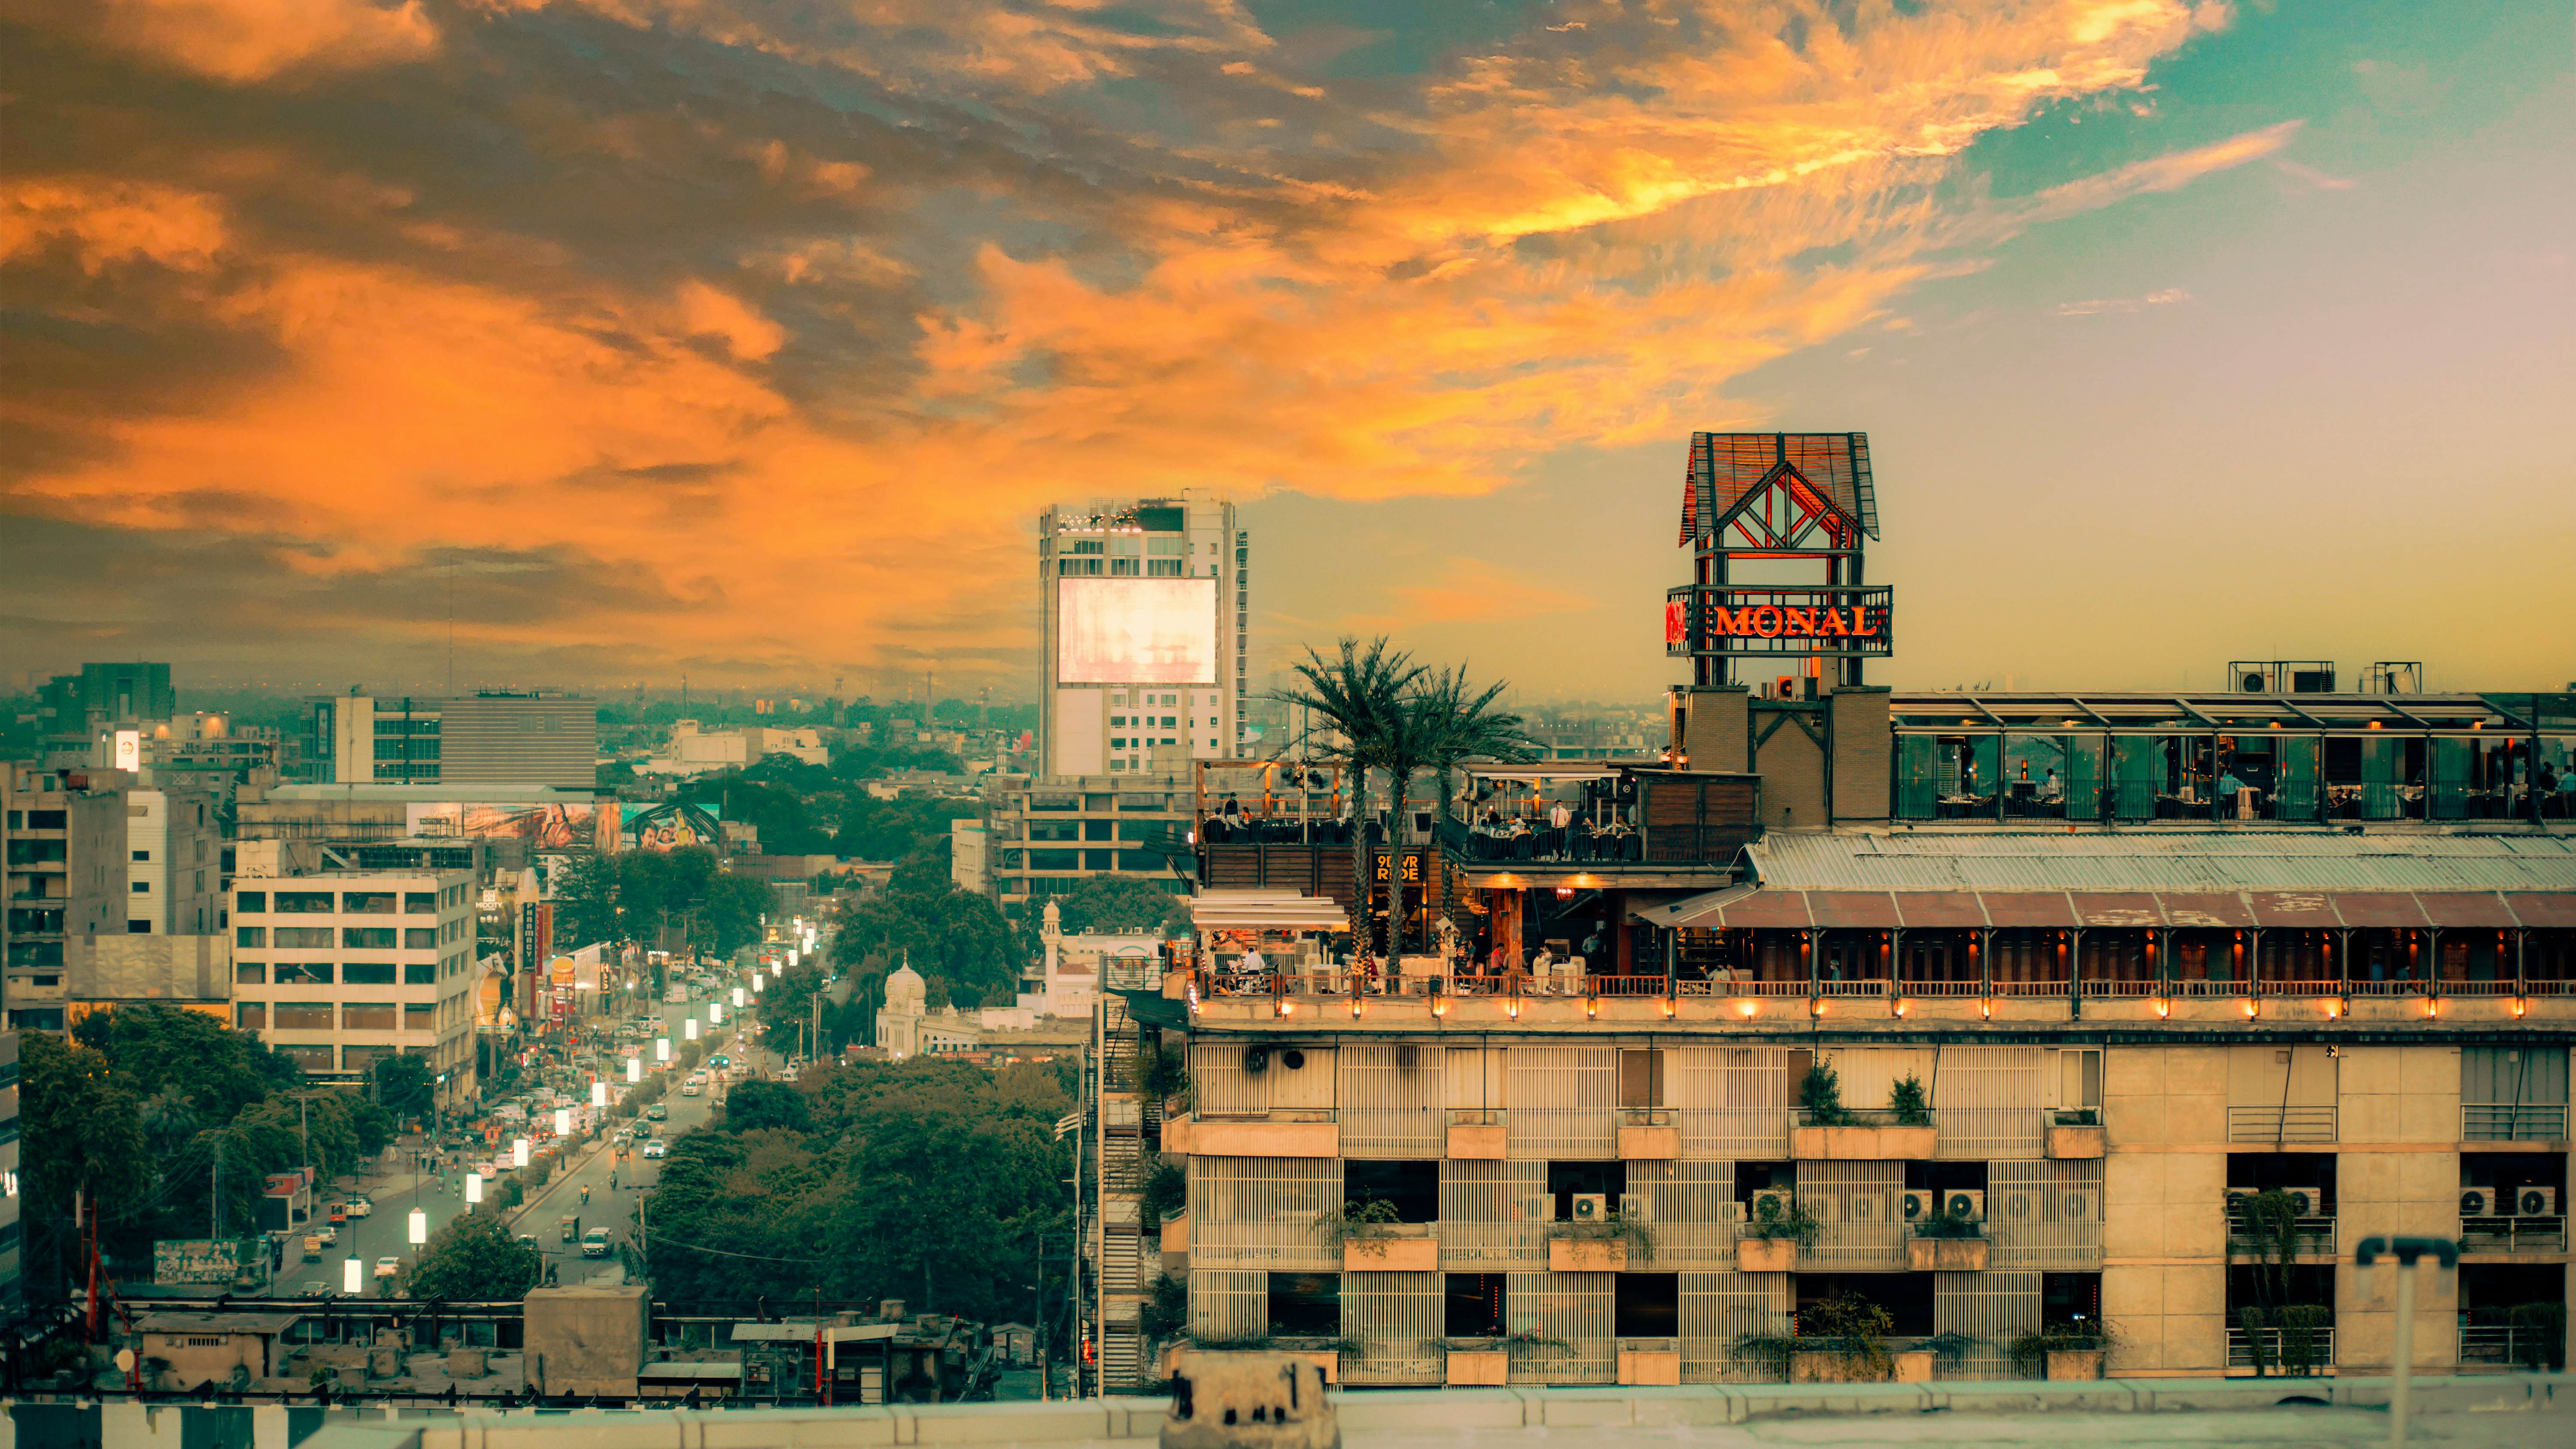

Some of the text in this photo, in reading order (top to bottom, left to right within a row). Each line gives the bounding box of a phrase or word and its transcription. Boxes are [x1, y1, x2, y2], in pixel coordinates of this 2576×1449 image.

[1714, 605, 1877, 638] MONAL
[1403, 856, 1418, 867] VR
[525, 903, 534, 957] PHARMACY
